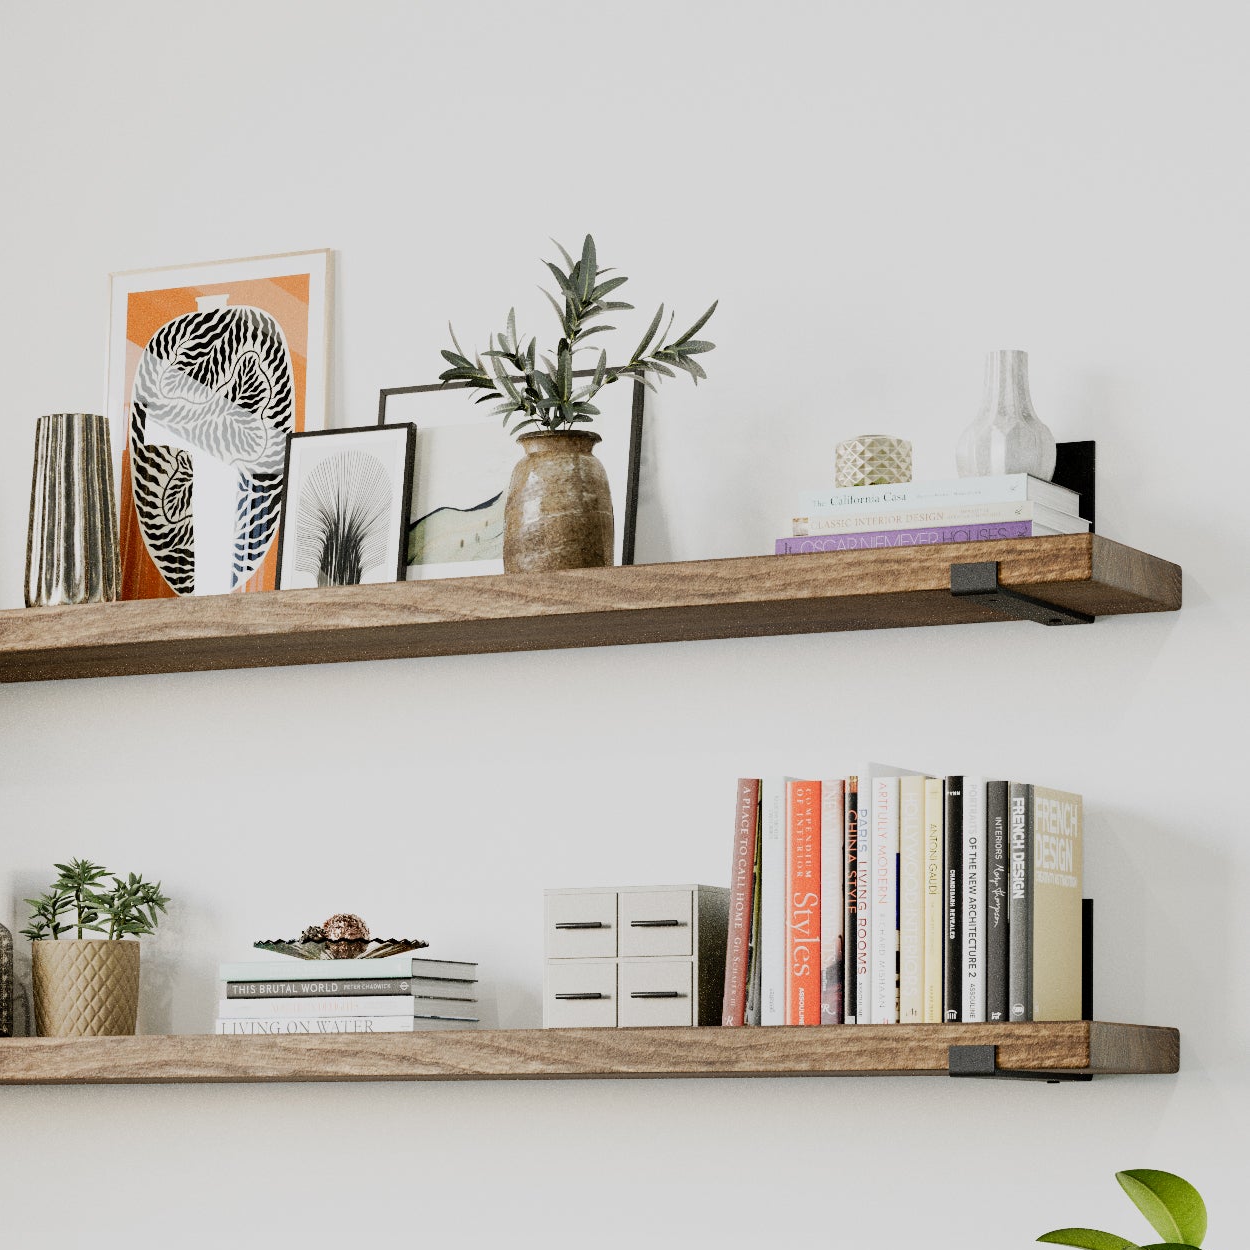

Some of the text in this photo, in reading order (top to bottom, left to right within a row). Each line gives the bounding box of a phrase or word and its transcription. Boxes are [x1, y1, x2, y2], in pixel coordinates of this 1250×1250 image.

[830, 494, 880, 506] California
[855, 515, 902, 527] INTERIOR
[906, 512, 944, 522] DESIGN
[796, 788, 803, 804] OF
[878, 782, 887, 839] ARTFULLY
[968, 784, 977, 834] PORTRAITS
[739, 797, 750, 835] PLACE
[1035, 797, 1078, 838] FRENCH
[739, 837, 748, 856] TO
[928, 823, 937, 860] ANTONI
[968, 836, 977, 850] OF
[1012, 797, 1025, 899] FRENCH DESIGN
[1035, 833, 1073, 873] DESIGN
[737, 858, 747, 889] CALL
[847, 809, 857, 914] CHINA STYLE
[878, 846, 887, 904] MODERN
[968, 852, 977, 870] THE
[858, 808, 867, 975] PARIS LIVING ROOMS
[903, 792, 918, 996] HOLLYWOOD INTERIORS
[968, 872, 977, 896] NEW
[734, 892, 744, 929] HOME
[790, 892, 820, 977] Styles
[968, 897, 977, 969] ARCHITECTURE
[233, 984, 255, 994] THIS
[259, 983, 298, 994] BRUTAL
[301, 982, 338, 992] WORLD
[221, 1020, 374, 1034] LIVING ON WATER
